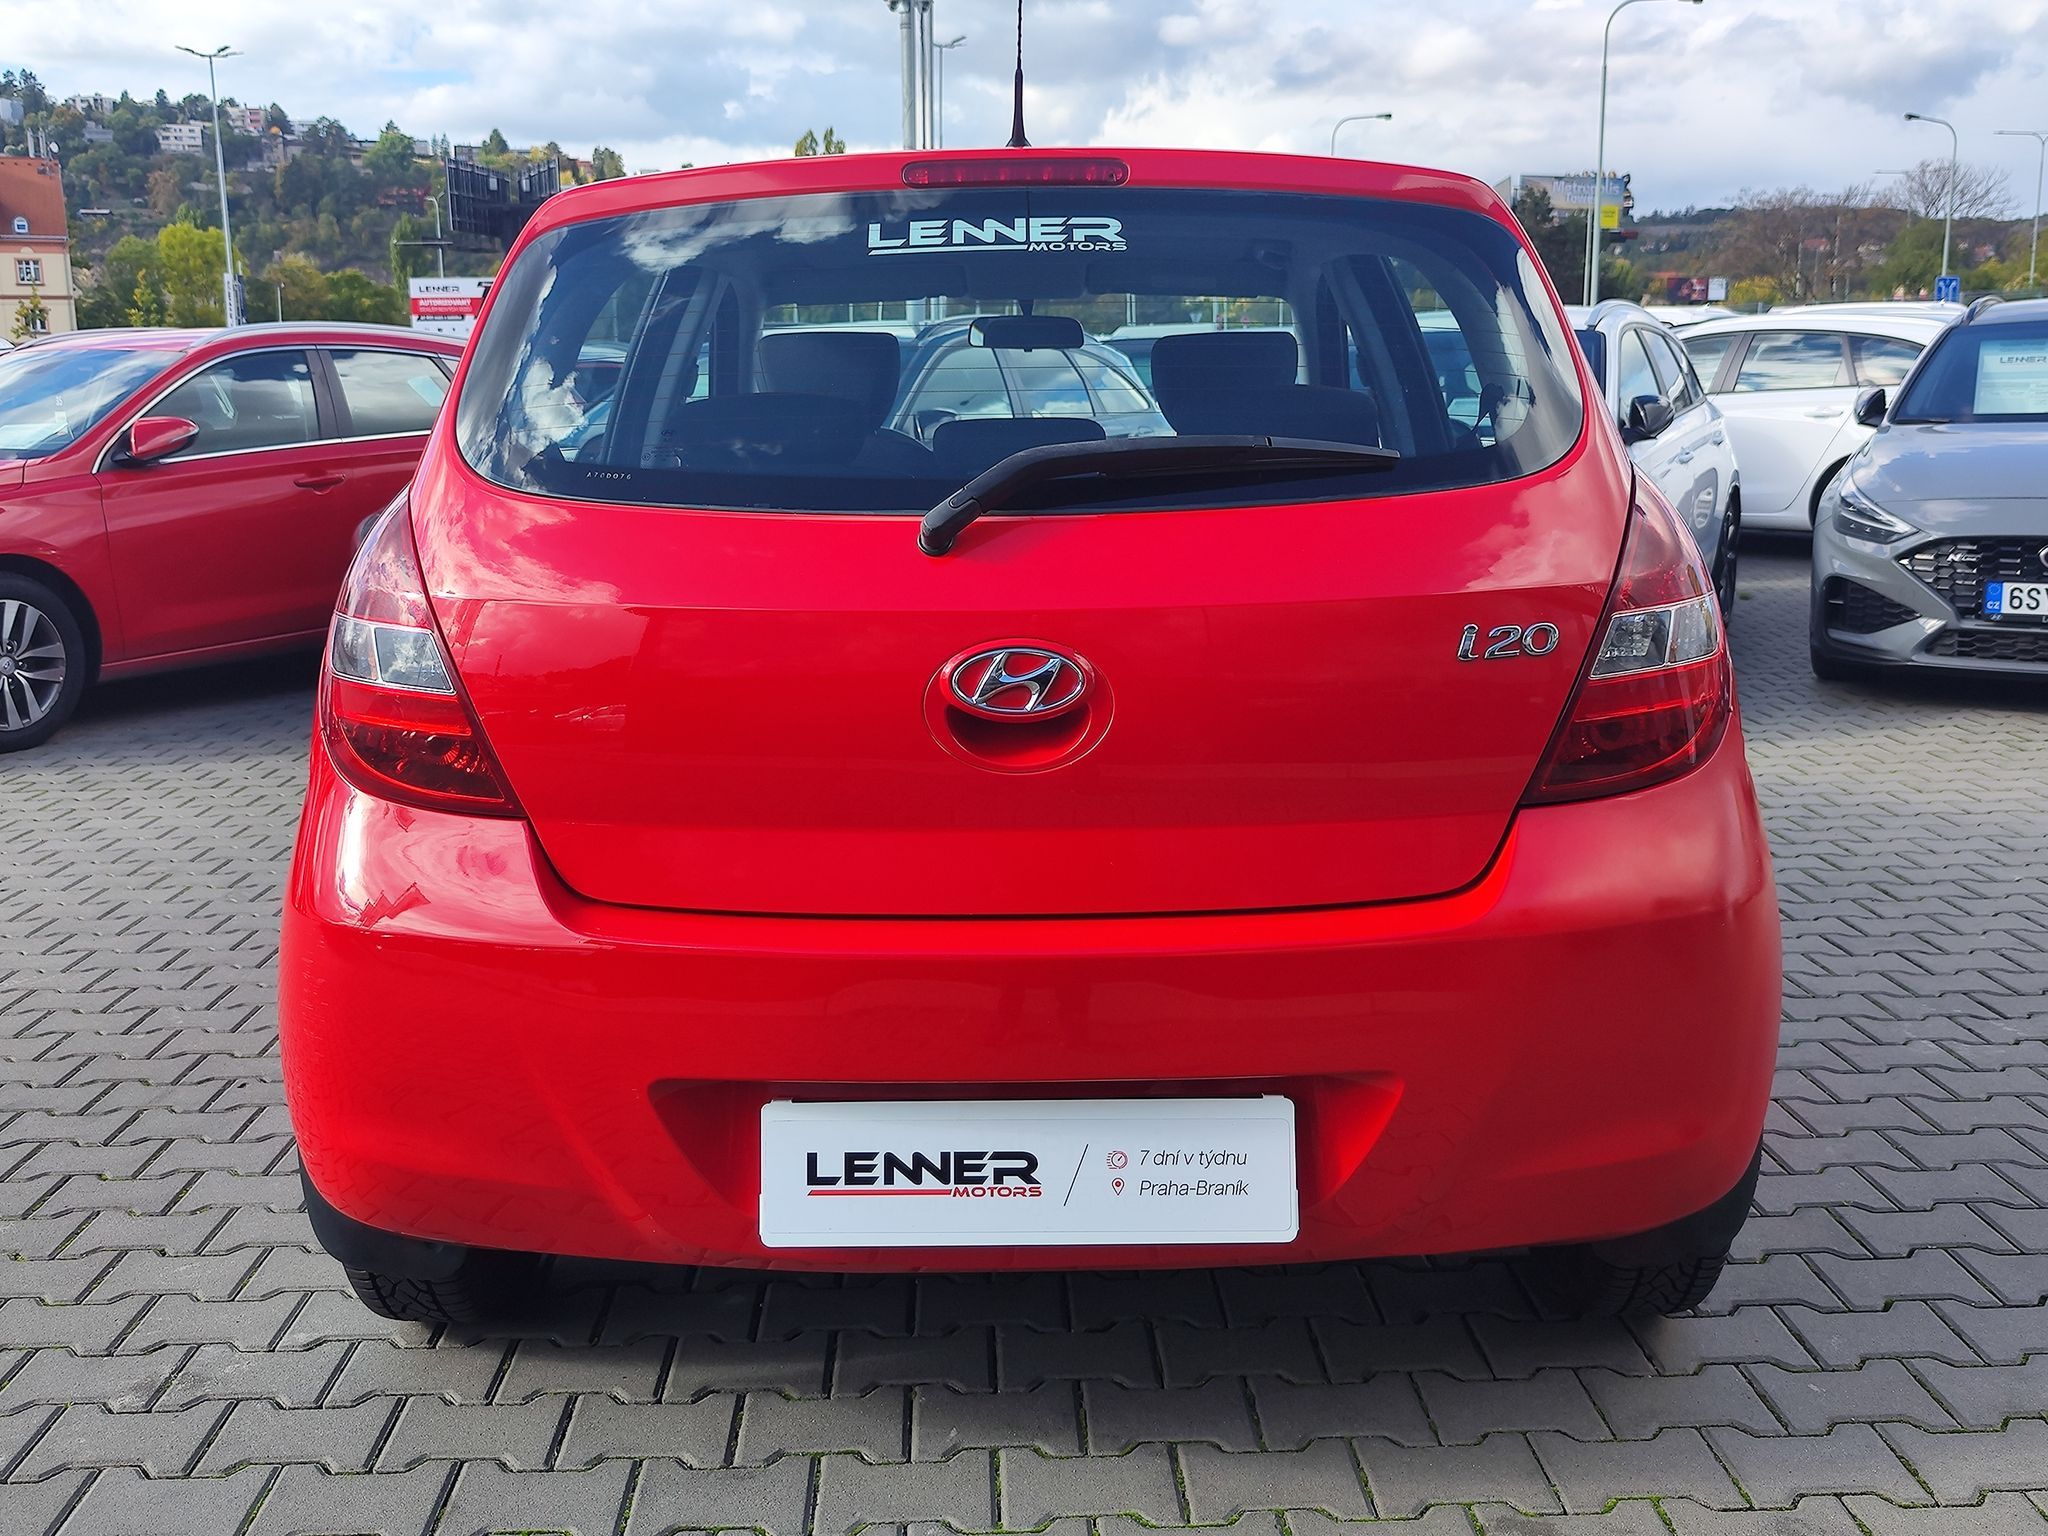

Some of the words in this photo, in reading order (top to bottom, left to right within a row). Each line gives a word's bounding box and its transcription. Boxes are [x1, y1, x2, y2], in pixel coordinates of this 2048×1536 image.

[867, 216, 1126, 248] LENNER
[1028, 241, 1128, 252] MOTORS
[2000, 356, 2047, 364] LENNER
[1986, 601, 2000, 609] CZ
[1457, 622, 1560, 661] i20
[1140, 1149, 1150, 1166] 7
[1153, 1149, 1181, 1166] dní
[1183, 1153, 1195, 1166] v
[1198, 1149, 1247, 1170] týdnu
[806, 1151, 1042, 1186] LENNER
[952, 1186, 1042, 1198] MOTORS
[1139, 1179, 1249, 1196] Praha-Braník
